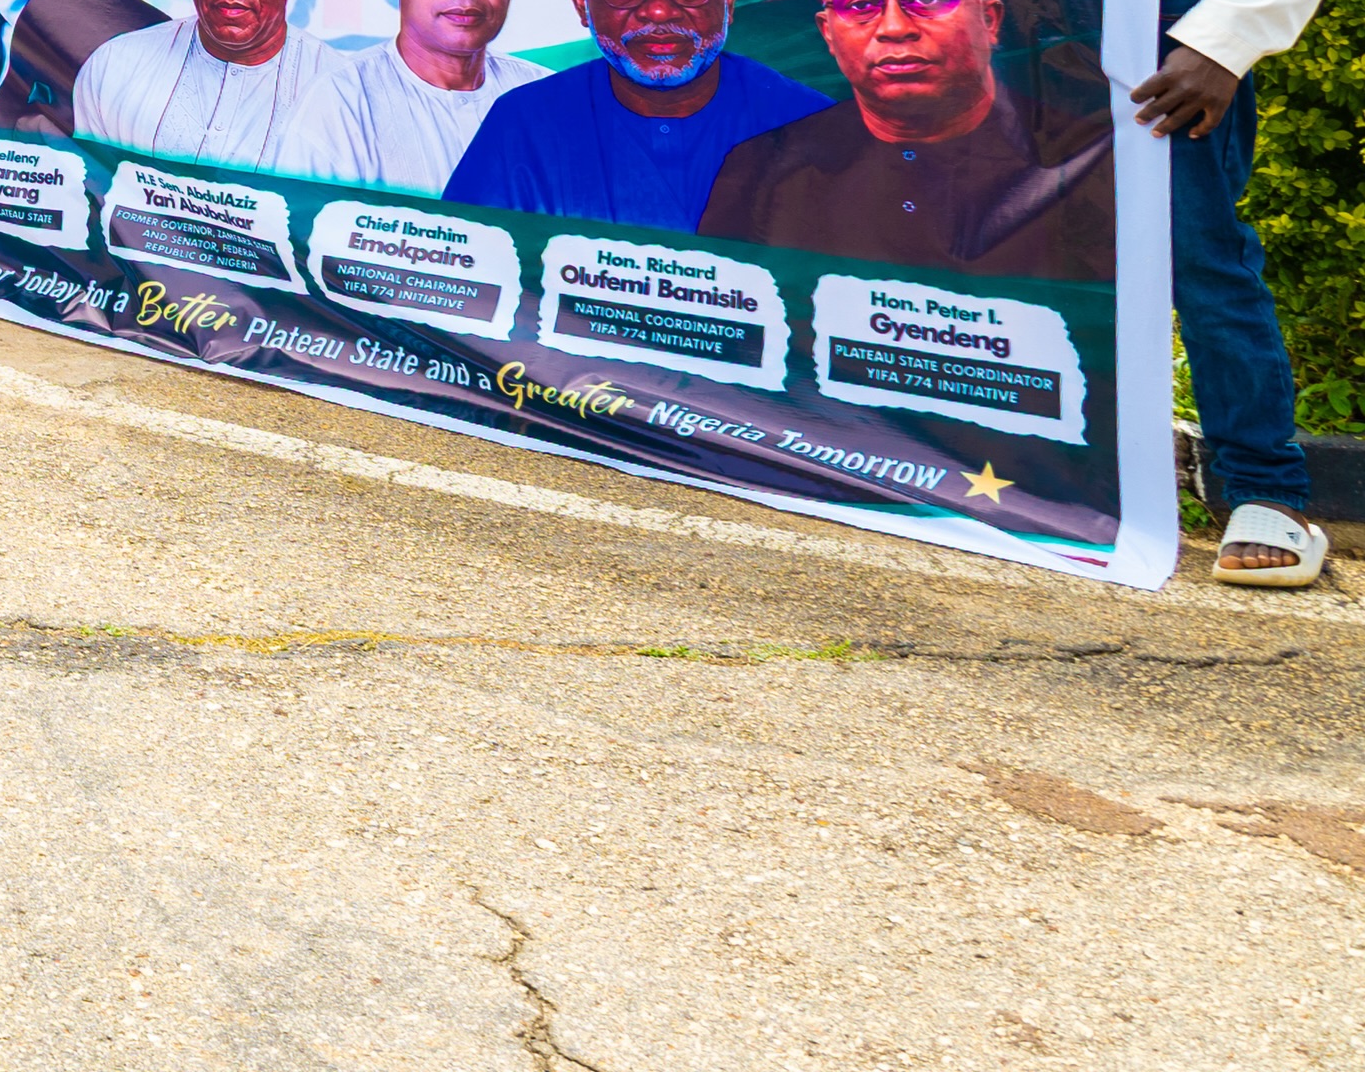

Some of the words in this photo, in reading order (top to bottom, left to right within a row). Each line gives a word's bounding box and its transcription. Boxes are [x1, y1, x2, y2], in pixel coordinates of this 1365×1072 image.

[136, 171, 156, 187] H.E
[158, 178, 184, 195] Sen.
[187, 186, 257, 210] AbdulAziz
[27, 213, 53, 224] STATE
[116, 210, 159, 226] FORMER
[161, 219, 216, 238] GOVERNOR,
[143, 188, 175, 208] Yari
[180, 197, 254, 230] Abubakar
[142, 229, 168, 241] AND
[171, 236, 218, 253] SENATOR,
[222, 243, 260, 259] FEDERAL
[356, 215, 399, 233] Chief
[403, 222, 467, 244] Ibrahim
[145, 241, 195, 260] REPUBLIC
[199, 253, 213, 263] OF
[217, 256, 257, 272] NIGERIA
[348, 232, 475, 268] Emokpaire
[597, 250, 641, 270] Hon.
[647, 257, 716, 281] Richard
[338, 264, 402, 285] NATIONAL
[406, 276, 478, 298] CHAIRMAN
[343, 280, 368, 294] YIFA
[372, 285, 394, 298] 774
[399, 290, 465, 310] INITIATIVE
[560, 264, 650, 296] Olufemi
[657, 278, 758, 312] Bamisile
[574, 302, 641, 323] NATIONAL
[645, 314, 745, 340] COORDINATOR
[871, 291, 920, 313] Hon.
[926, 299, 982, 322] Peter
[988, 309, 1003, 325] I.
[589, 322, 617, 335] YIFA
[622, 326, 647, 341] 774
[651, 332, 723, 354] INITIATIVE
[869, 312, 1010, 358] Gyendeng
[14, 265, 83, 304] Today
[81, 280, 112, 308] for
[114, 292, 129, 313] a
[137, 280, 238, 334] Better
[243, 316, 345, 360] Plateau
[349, 337, 420, 375] State
[425, 359, 470, 387] and
[477, 372, 492, 390] a
[495, 361, 637, 418] Greater
[646, 401, 767, 441] Nigeria
[776, 429, 948, 490] Tomorrow
[835, 344, 895, 365] PLATEAU
[899, 354, 939, 371] STATE
[942, 362, 1054, 391] COORDINATOR
[866, 367, 900, 384] YIFA
[904, 374, 932, 389] 774
[938, 379, 1019, 403] INITIATIVE
